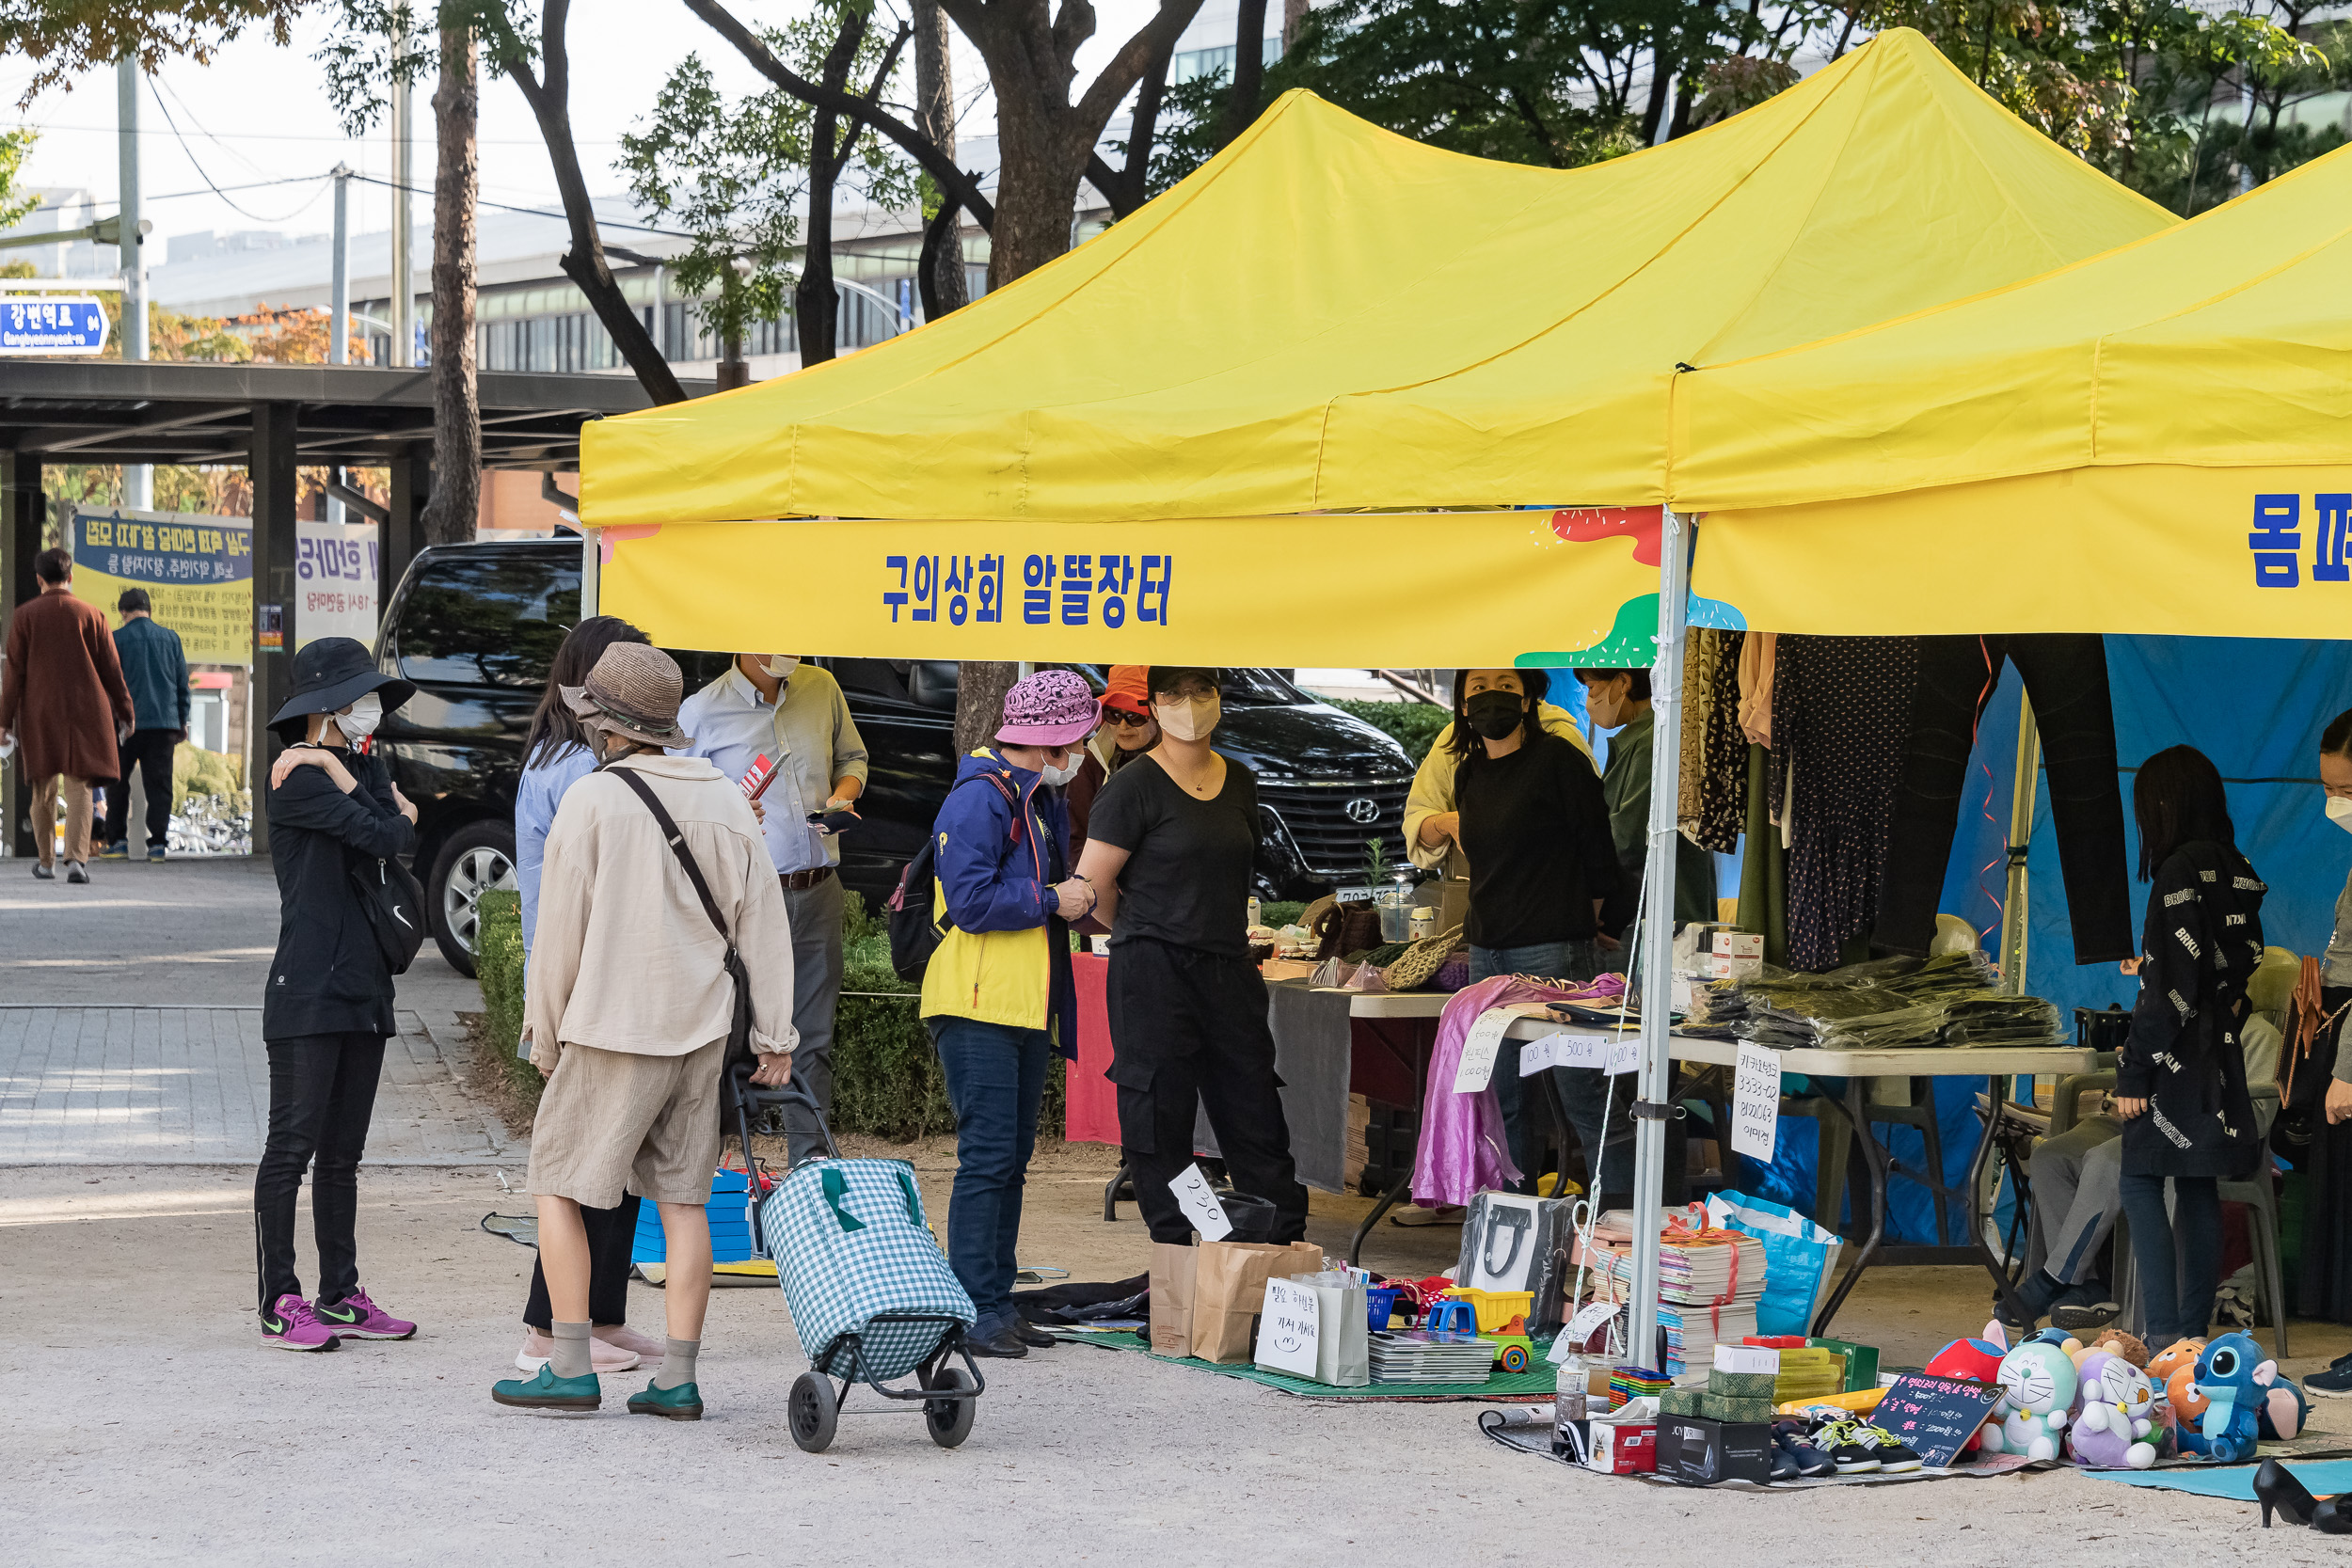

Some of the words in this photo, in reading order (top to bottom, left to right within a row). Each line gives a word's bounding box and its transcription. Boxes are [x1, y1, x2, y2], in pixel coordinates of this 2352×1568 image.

[10, 303, 74, 330] 강변역로
[882, 553, 1006, 626] 구의상회
[1022, 553, 1174, 629] 알뜰장터
[2174, 927, 2201, 960] BRKLN
[1465, 1045, 1490, 1061] 원피스
[1527, 1046, 1539, 1064] 100
[1566, 1039, 1583, 1057] 500
[1739, 1074, 1777, 1102] 3333-02
[1743, 1125, 1770, 1147] 이미경
[1186, 1179, 1219, 1221] 230
[1272, 1286, 1288, 1304] 필요
[1297, 1320, 1316, 1338] 가세요
[1672, 1425, 1683, 1437] JOY
